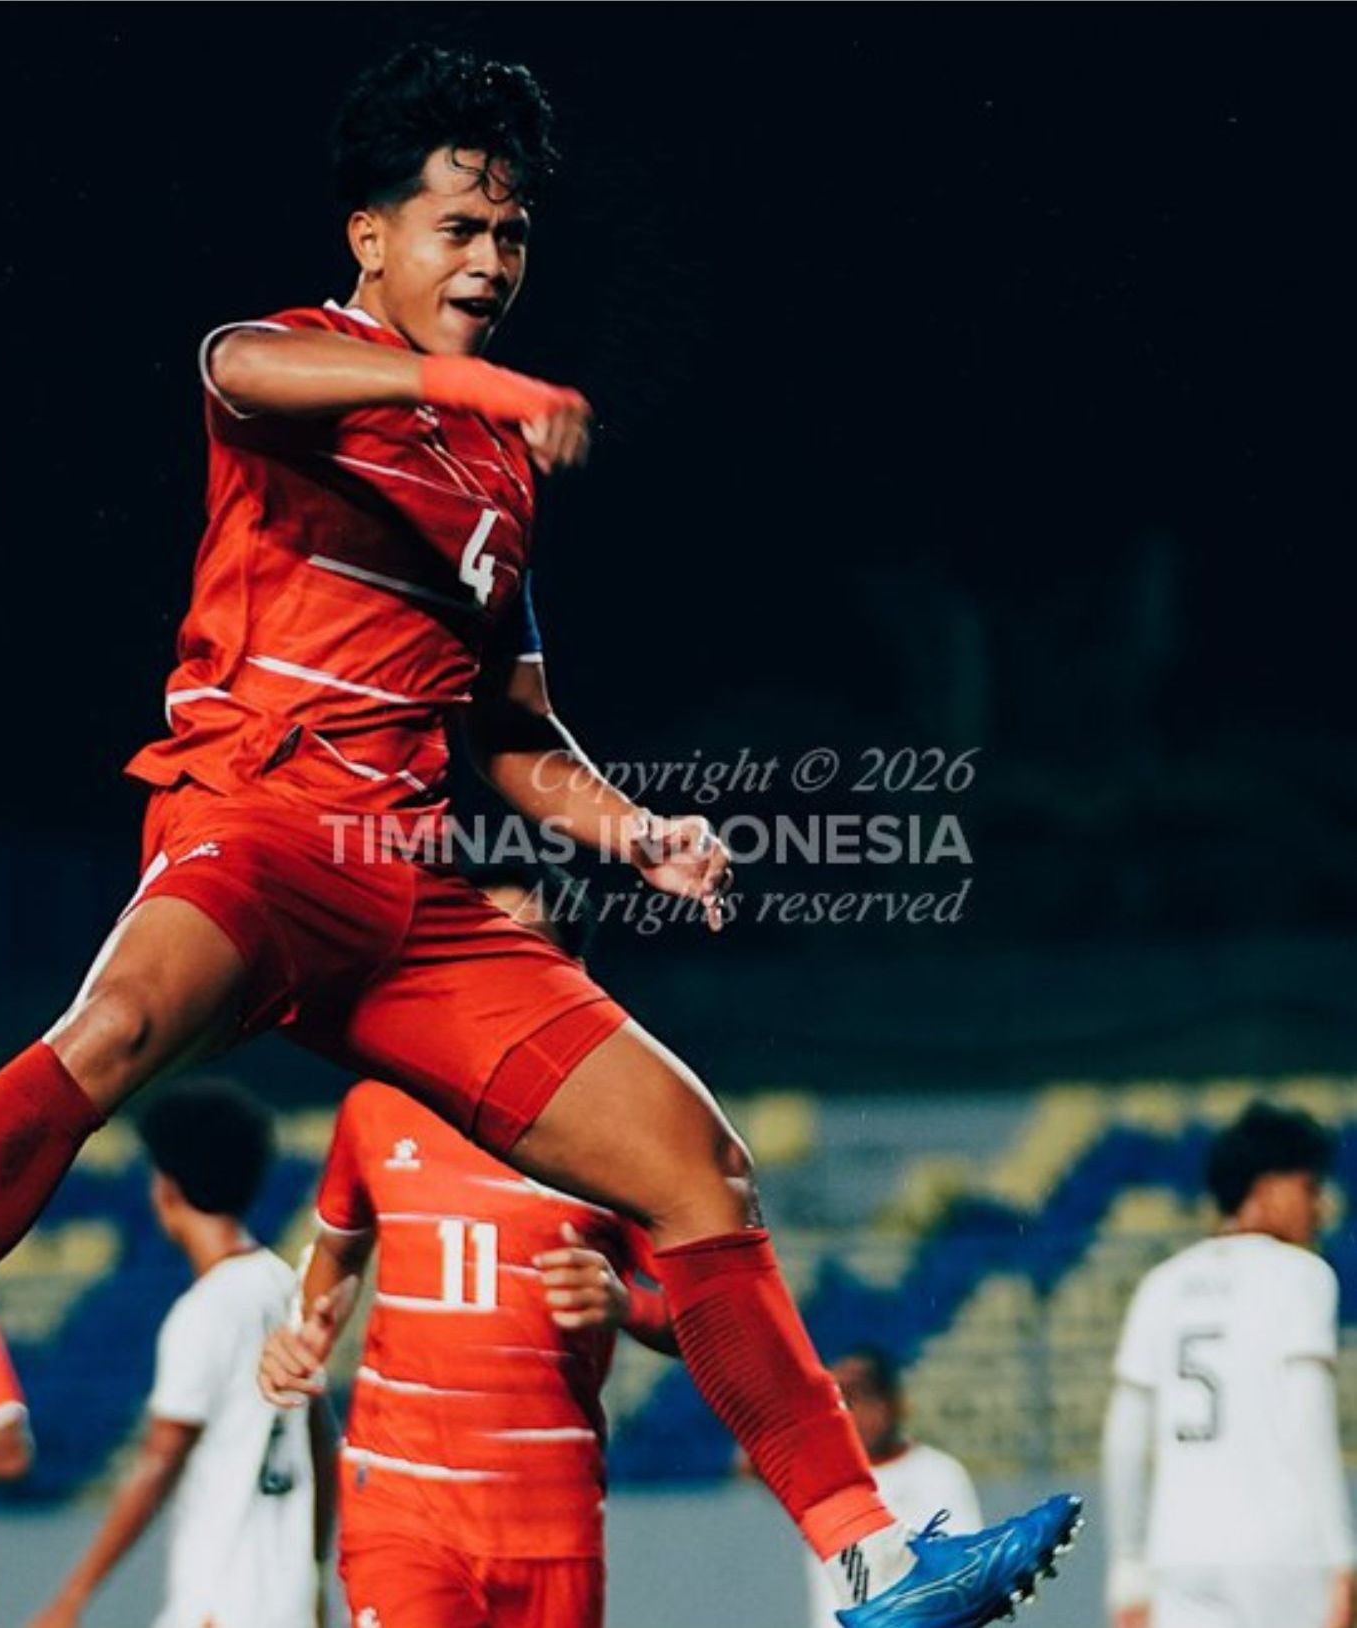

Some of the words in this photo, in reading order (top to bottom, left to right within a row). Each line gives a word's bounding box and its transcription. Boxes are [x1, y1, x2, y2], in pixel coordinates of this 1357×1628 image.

[459, 508, 499, 606] 4
[438, 1218, 499, 1311] 11
[1175, 1323, 1227, 1443] 5
